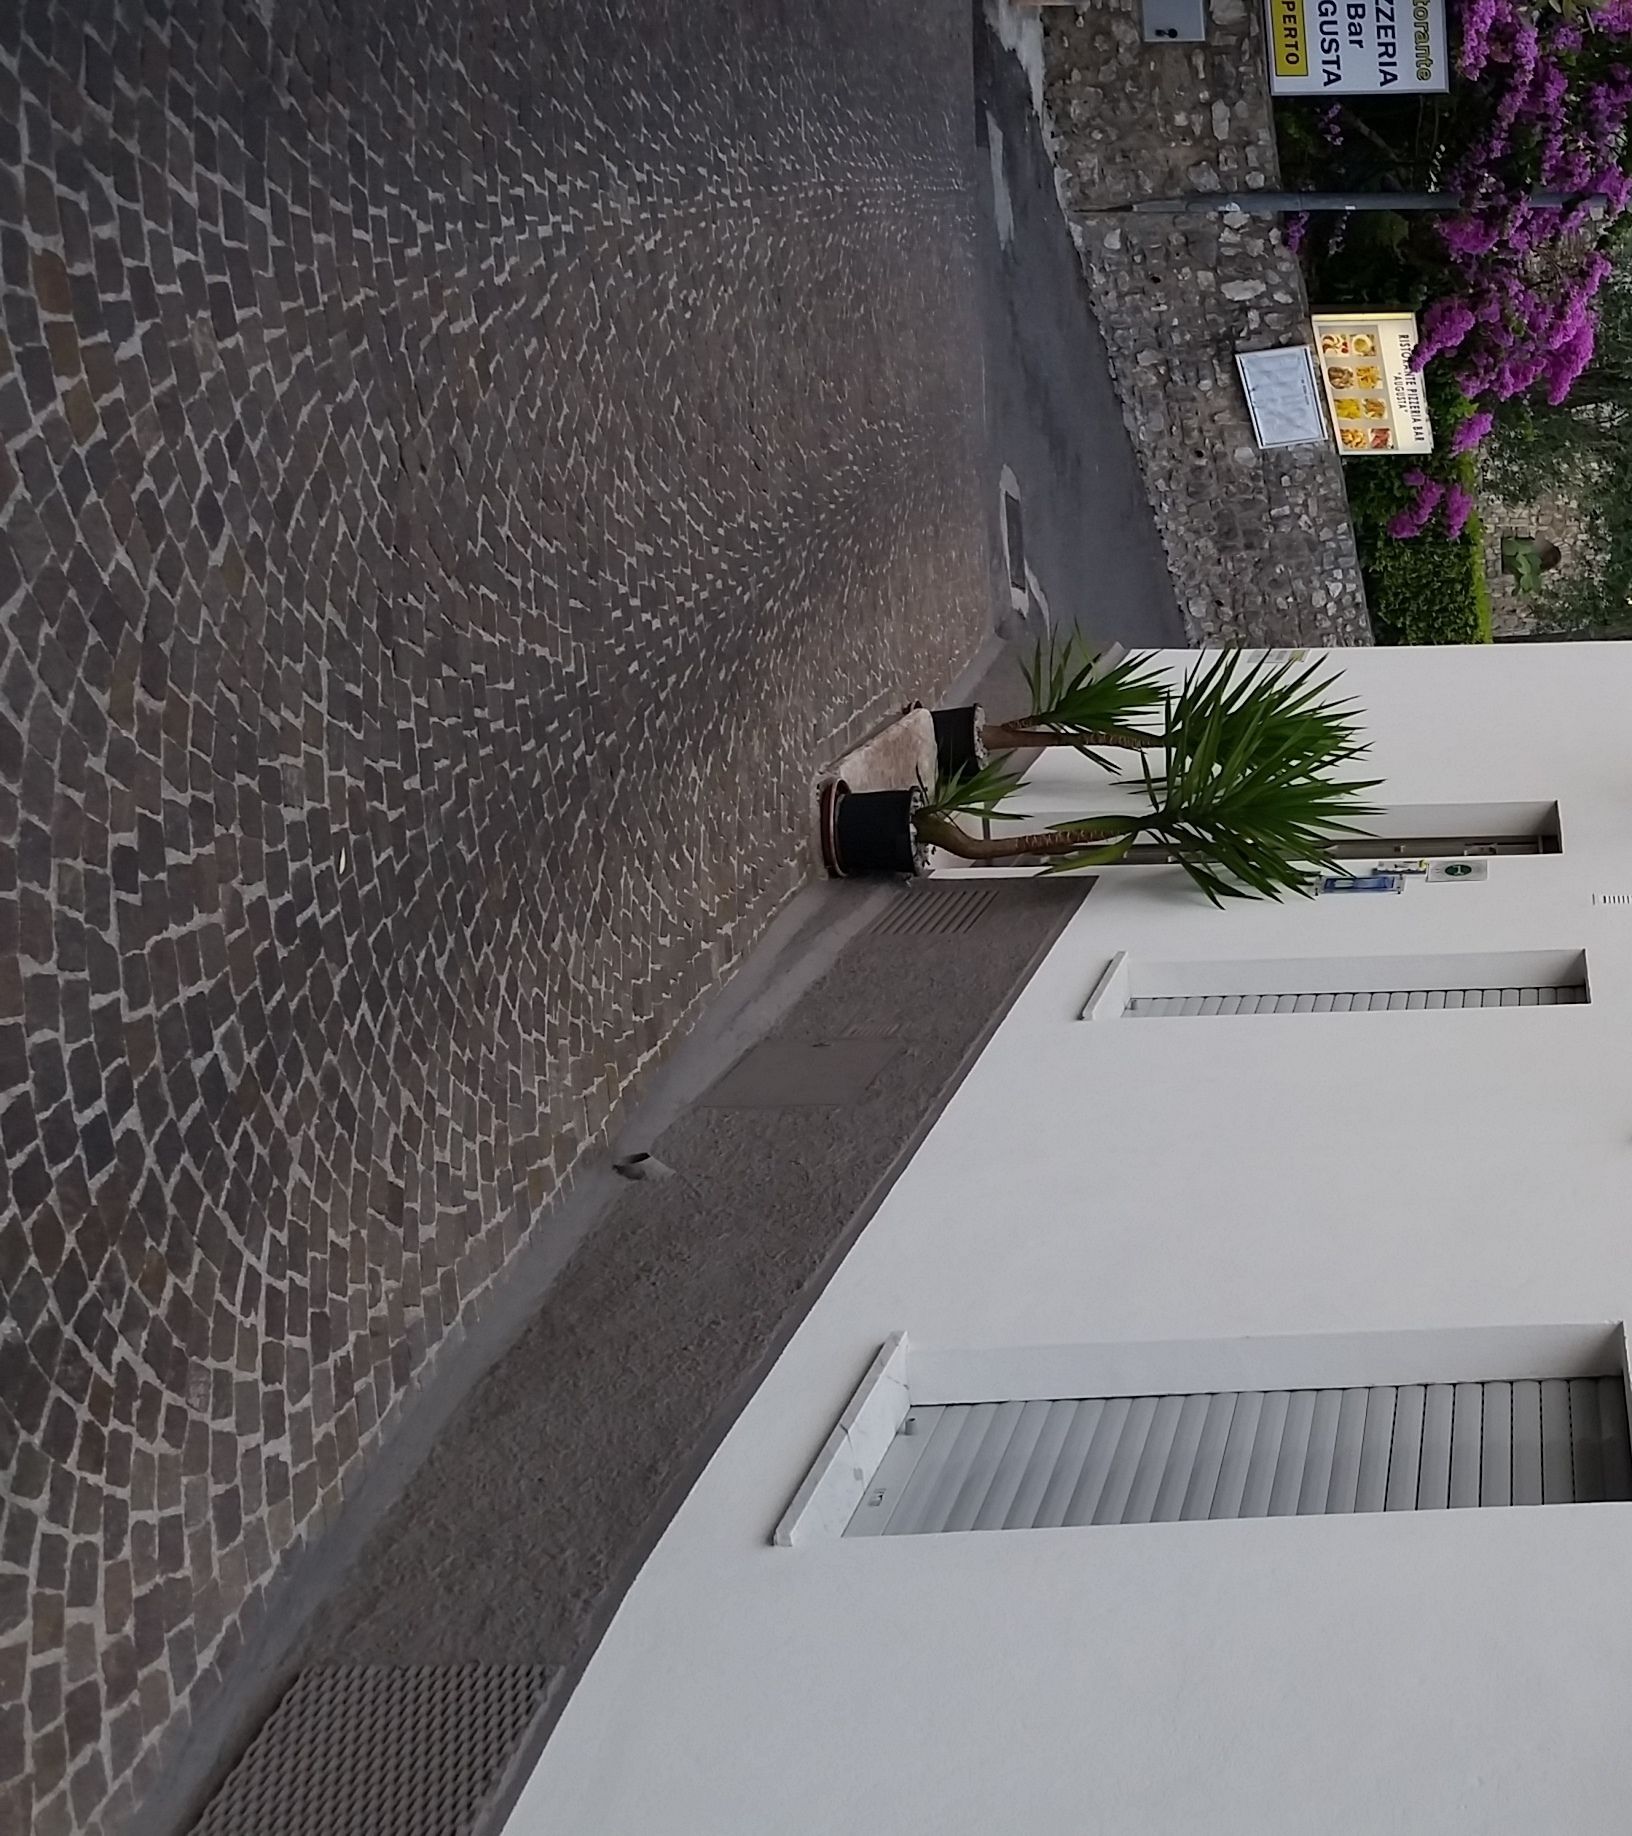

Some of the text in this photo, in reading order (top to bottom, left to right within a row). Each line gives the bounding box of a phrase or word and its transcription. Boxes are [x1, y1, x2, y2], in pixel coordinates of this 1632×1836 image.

[1281, 1, 1299, 65] PERTO
[1318, 0, 1342, 86] GUSTA
[1347, 4, 1366, 48] Bar
[1406, 389, 1422, 423] PIZZERIA
[1413, 426, 1424, 441] BAR
